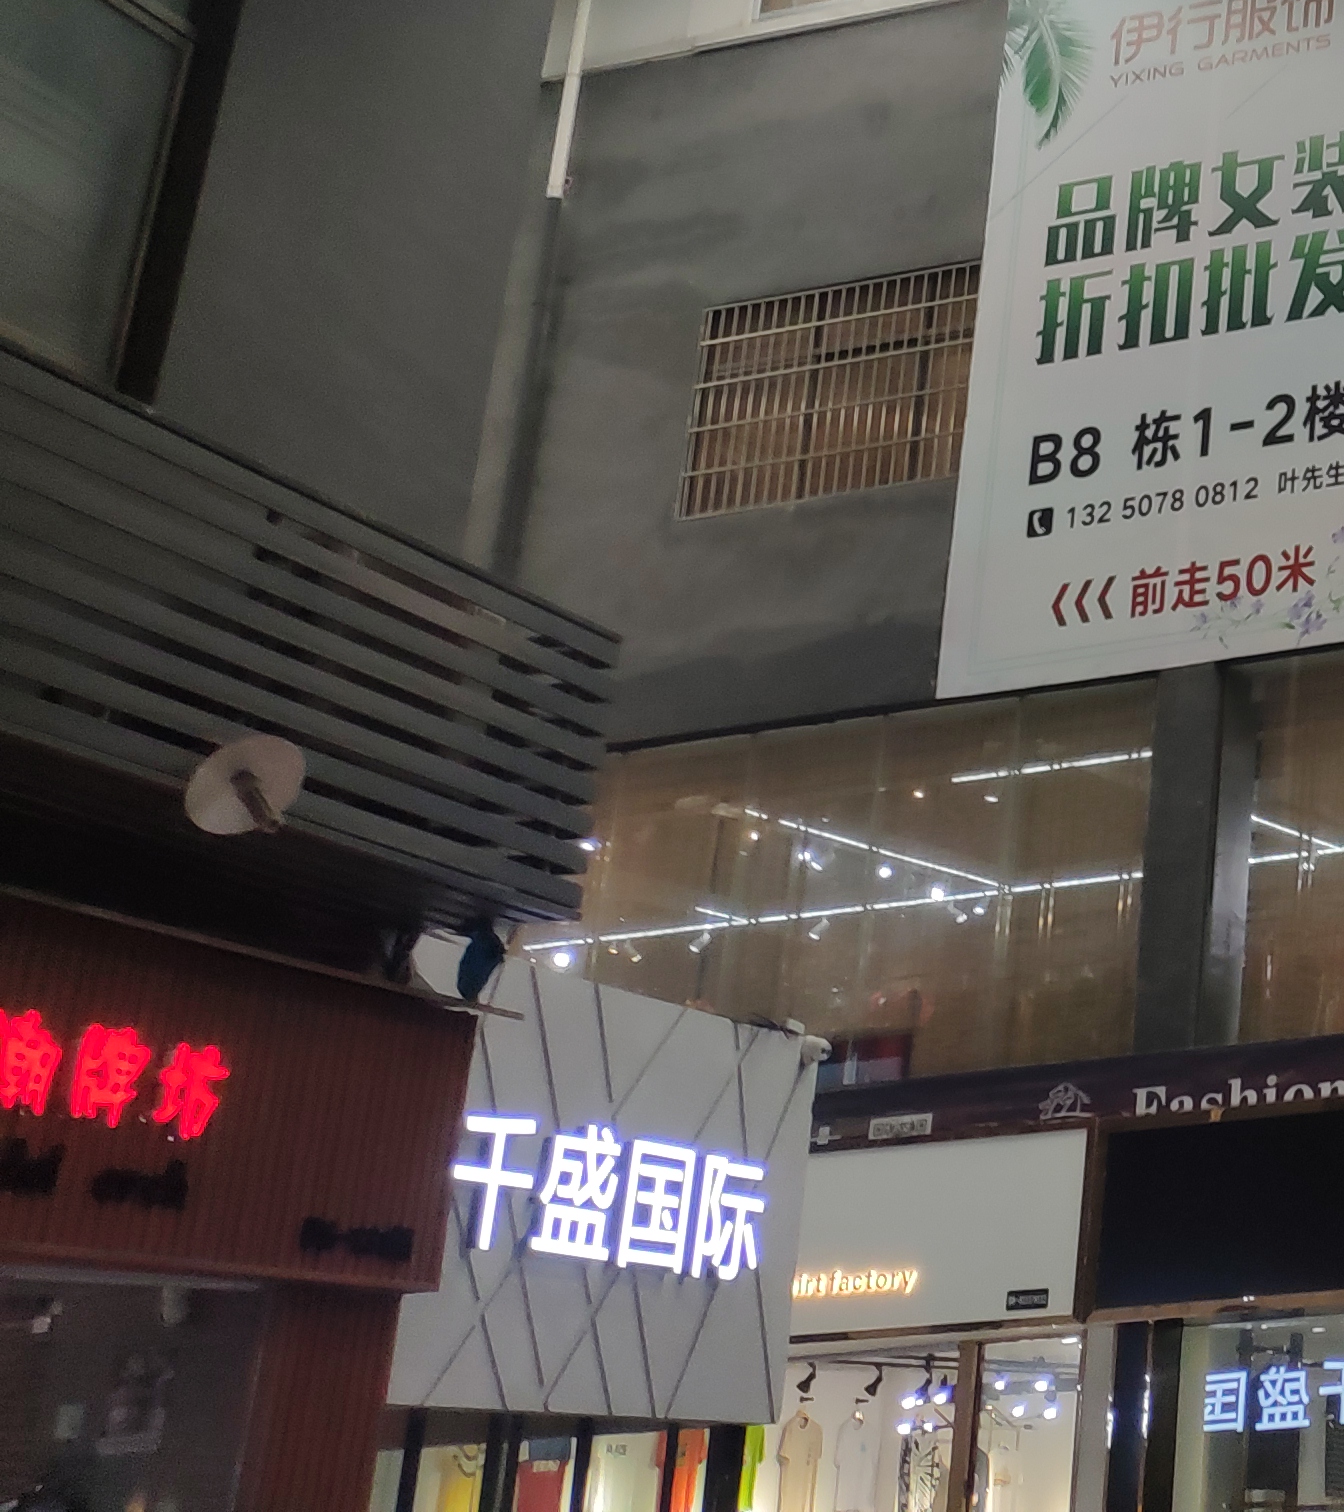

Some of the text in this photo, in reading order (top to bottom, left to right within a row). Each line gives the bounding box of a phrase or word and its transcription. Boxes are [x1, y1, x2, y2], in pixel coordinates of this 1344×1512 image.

[1109, 33, 1331, 88] YIXING GARMENTS
[1129, 543, 1316, 619] 前走50米
[450, 1113, 766, 1281] 千盛国际
[830, 1268, 918, 1296] factory
